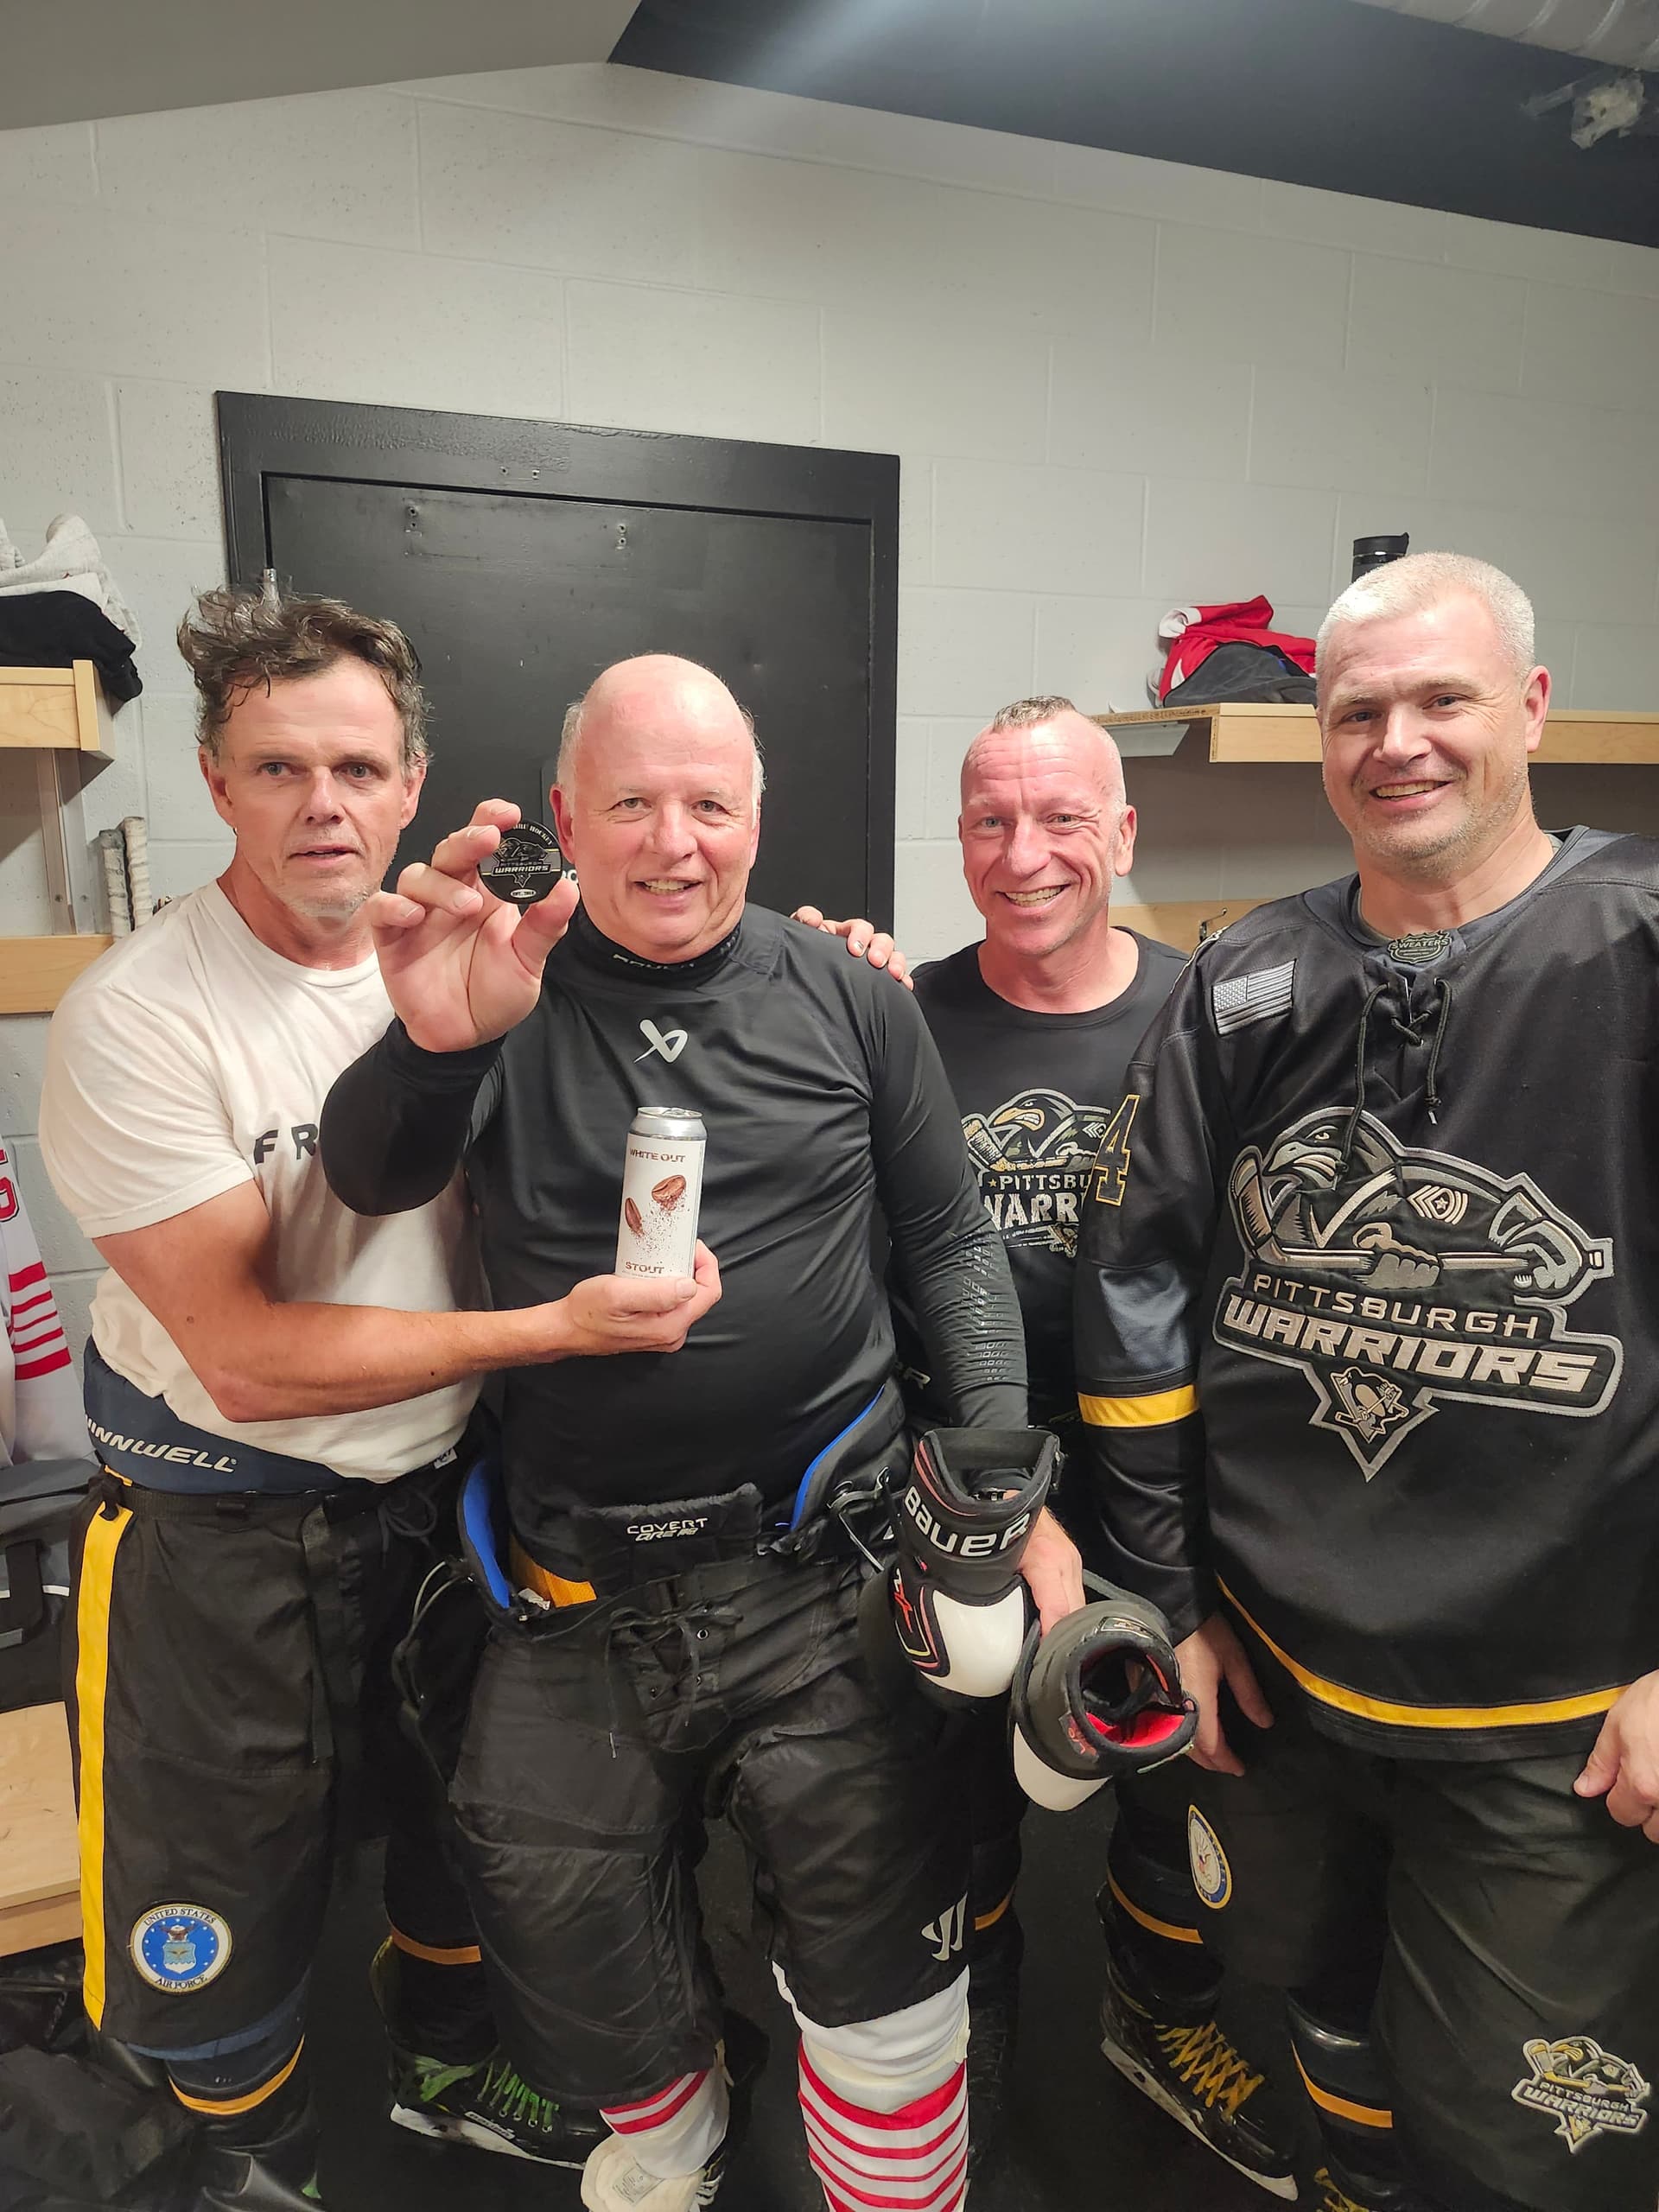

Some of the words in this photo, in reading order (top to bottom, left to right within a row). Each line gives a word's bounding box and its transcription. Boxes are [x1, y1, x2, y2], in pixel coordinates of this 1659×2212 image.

[494, 865, 549, 874] WARRIORS
[1390, 938, 1449, 950] SWEATERS
[629, 1147, 658, 1160] WHITE
[660, 1153, 686, 1163] OUT
[625, 1261, 664, 1274] STOUT
[1253, 1274, 1539, 1339] PITTSBURGH
[1223, 1294, 1597, 1392] WARRIORS
[626, 1517, 708, 1535] COVERT
[143, 1908, 178, 1926] UNITED
[180, 1907, 216, 1924] STATES
[156, 1977, 173, 1988] AIR
[174, 1975, 207, 1988] FORCE
[1523, 2086, 1640, 2126] WARRIORS
[1540, 2082, 1630, 2113] PITTSBURGH
